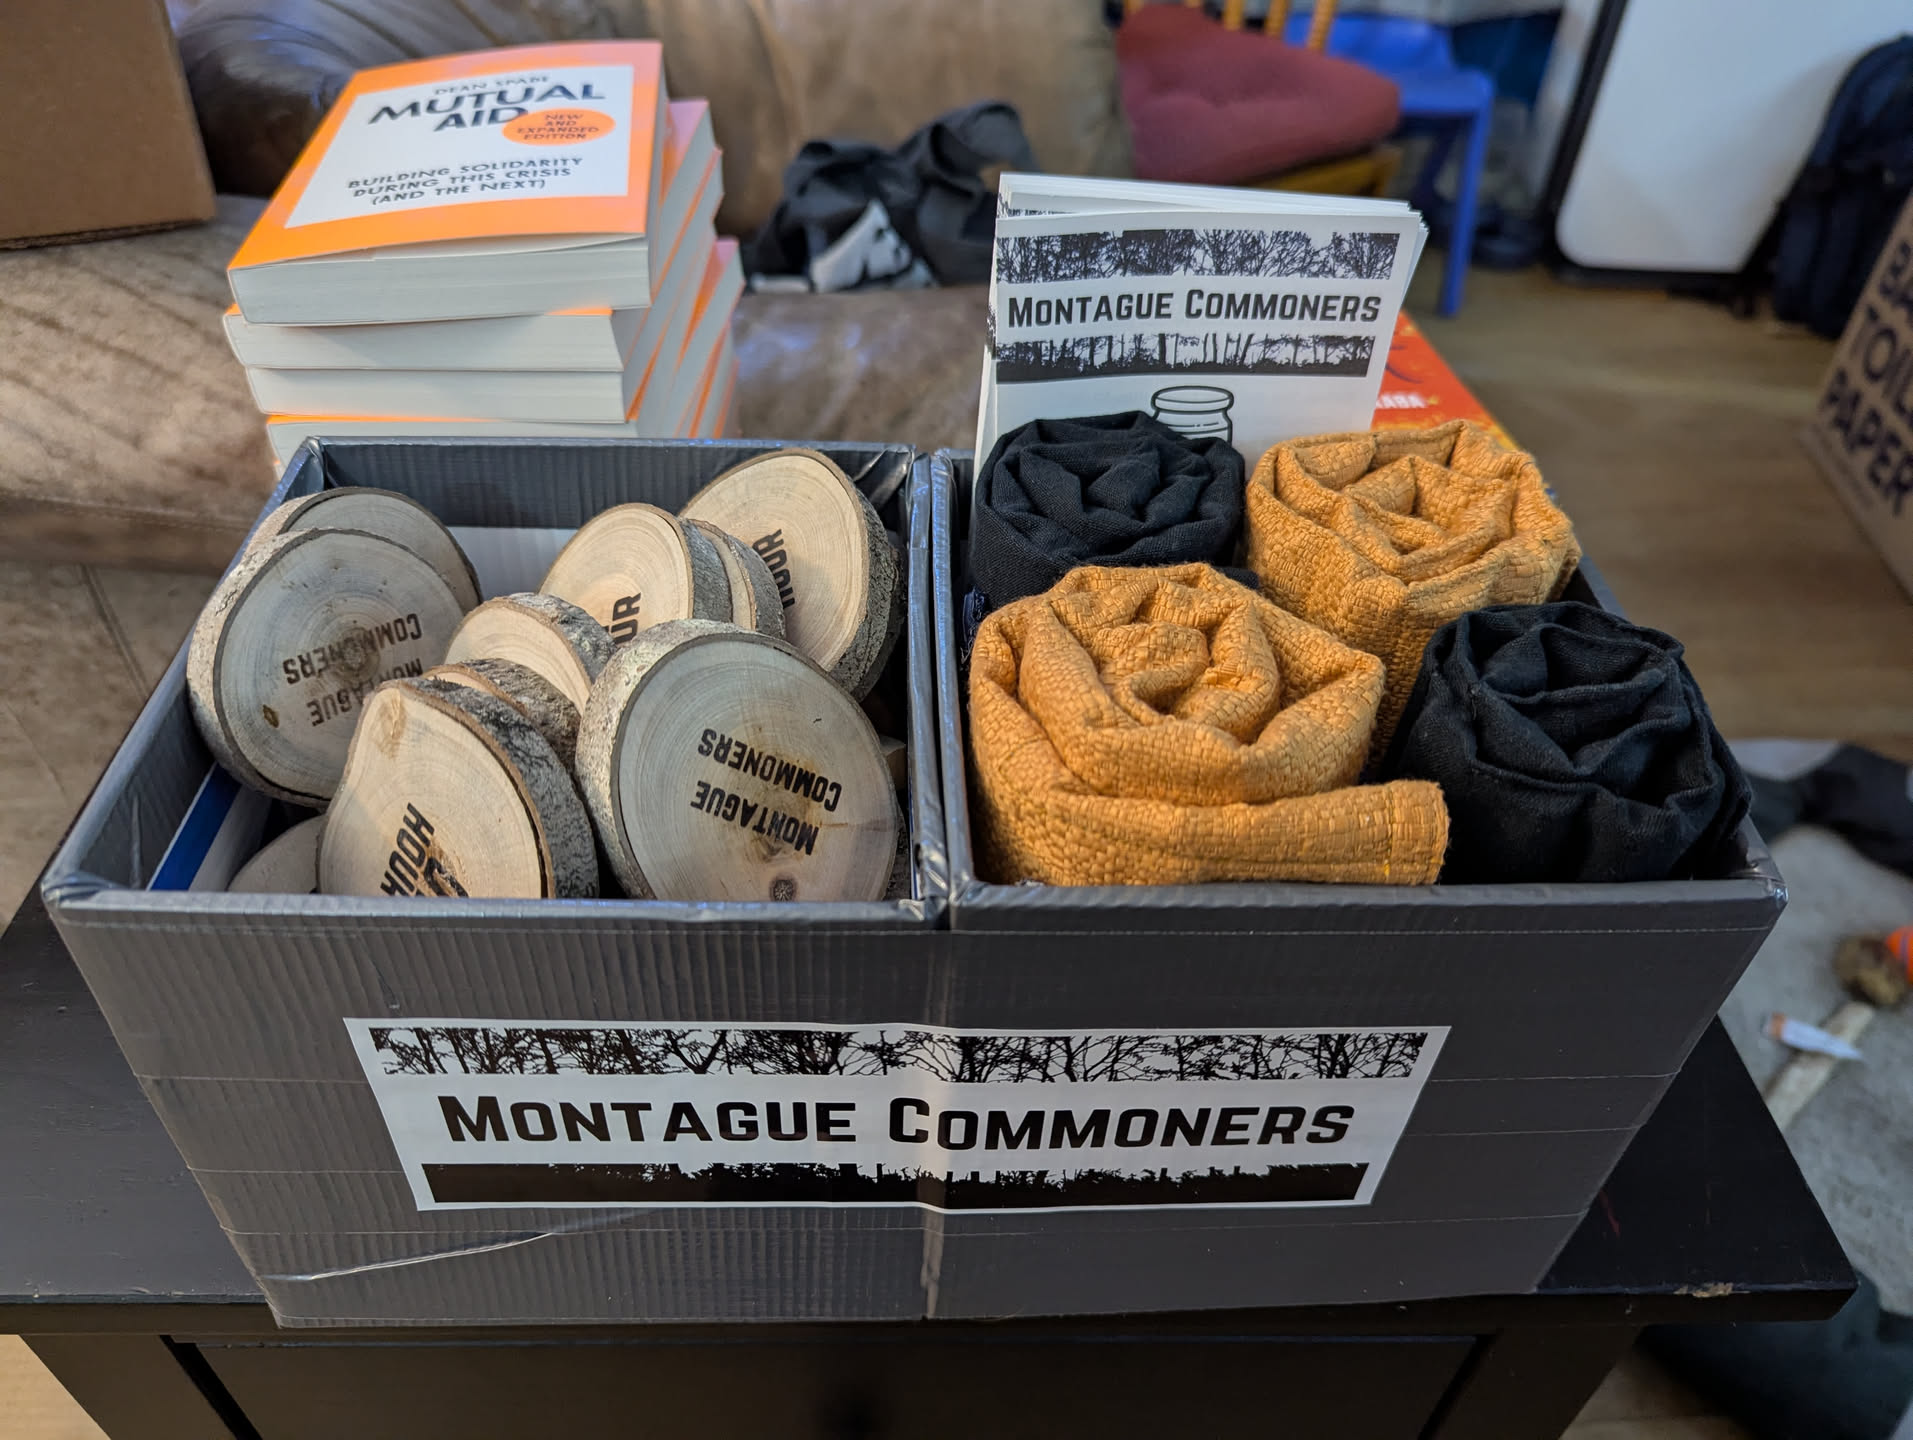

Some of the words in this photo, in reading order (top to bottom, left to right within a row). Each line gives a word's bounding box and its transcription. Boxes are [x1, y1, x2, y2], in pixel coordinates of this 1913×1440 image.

[368, 84, 606, 125] MUTUAL
[433, 106, 529, 132] AID
[544, 113, 584, 121] NEW
[517, 126, 600, 134] EXPANDED
[523, 132, 587, 140] EDITION
[347, 167, 451, 190] BUILDING
[459, 157, 584, 174] SOLIDARITY
[352, 178, 440, 198] DURING
[450, 173, 496, 185] THIS
[505, 168, 572, 180] CRISIS
[371, 190, 425, 206] (AND
[434, 185, 472, 196] THE
[480, 178, 547, 192] NEXT)
[1008, 292, 1175, 329] MONTAGUE
[1184, 289, 1383, 323] COMMONERS
[604, 591, 642, 645] UR
[697, 728, 843, 813] COMMONERS
[690, 780, 820, 857] MONTAGUE
[437, 1095, 857, 1142] MONTAGUE
[888, 1096, 1356, 1151] COMMONERS
